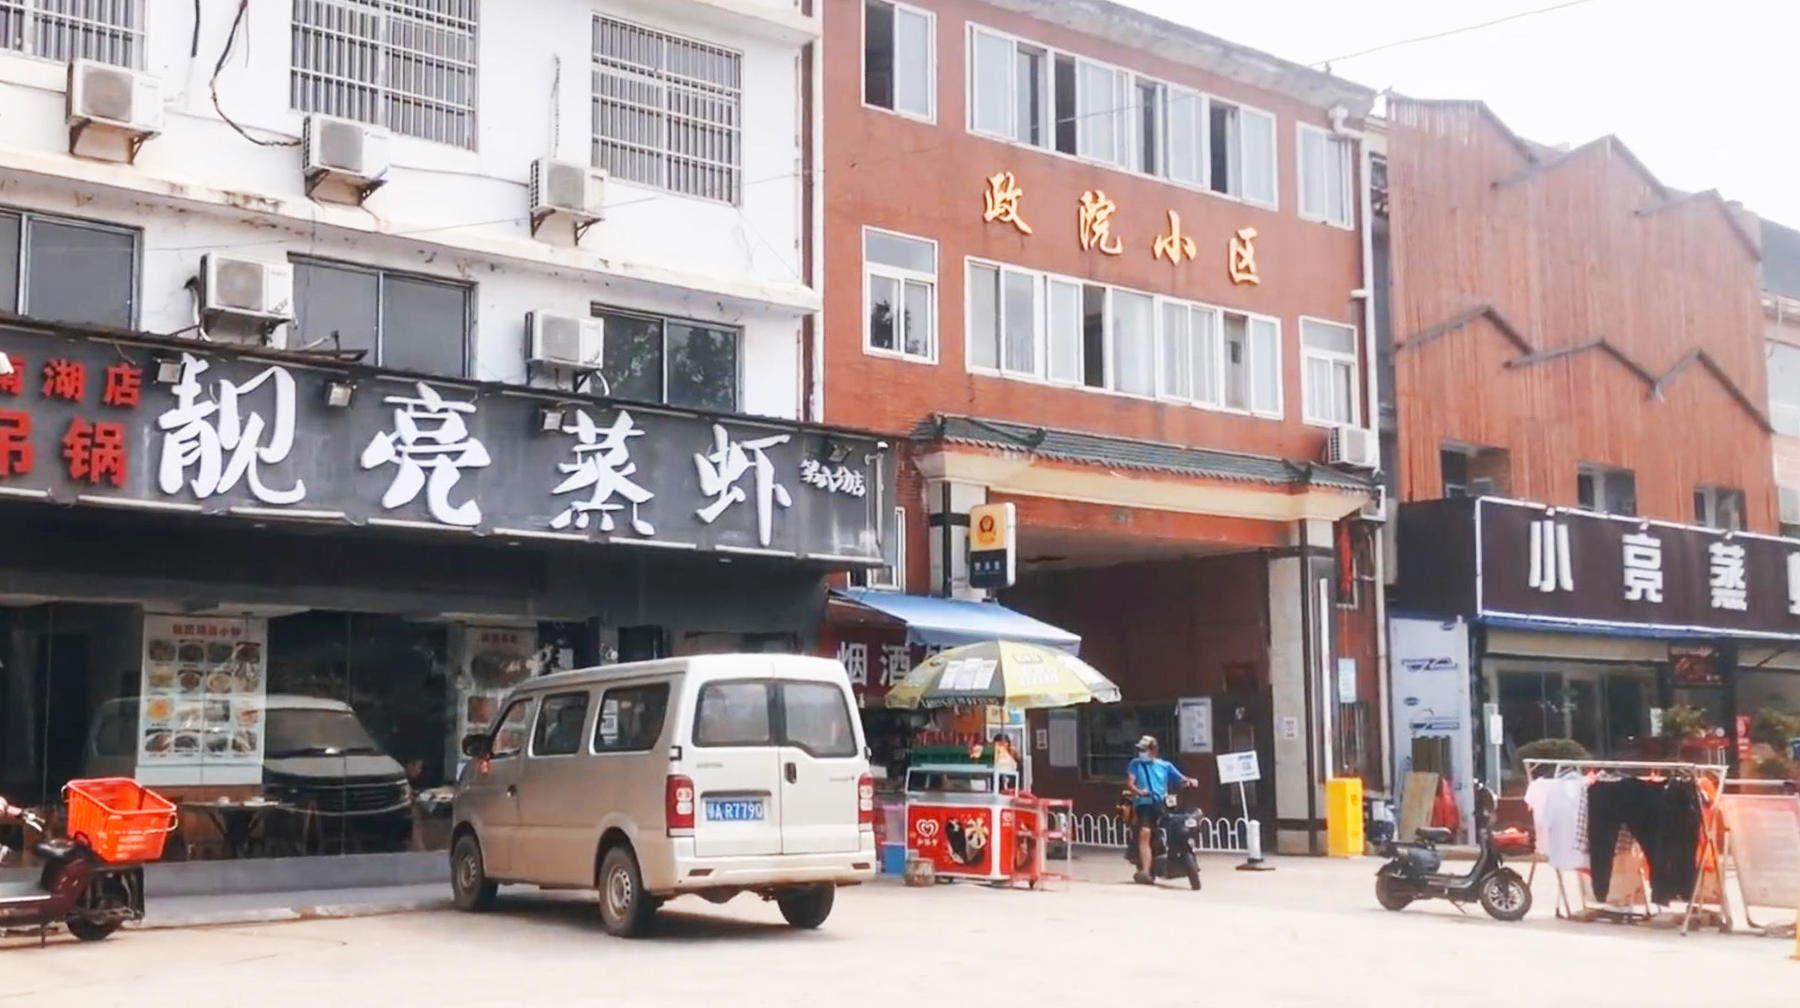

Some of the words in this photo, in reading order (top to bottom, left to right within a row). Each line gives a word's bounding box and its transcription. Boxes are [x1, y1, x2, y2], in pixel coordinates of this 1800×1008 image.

[983, 171, 1260, 284] 政院小区
[156, 352, 792, 547] 靓亮蒸虾
